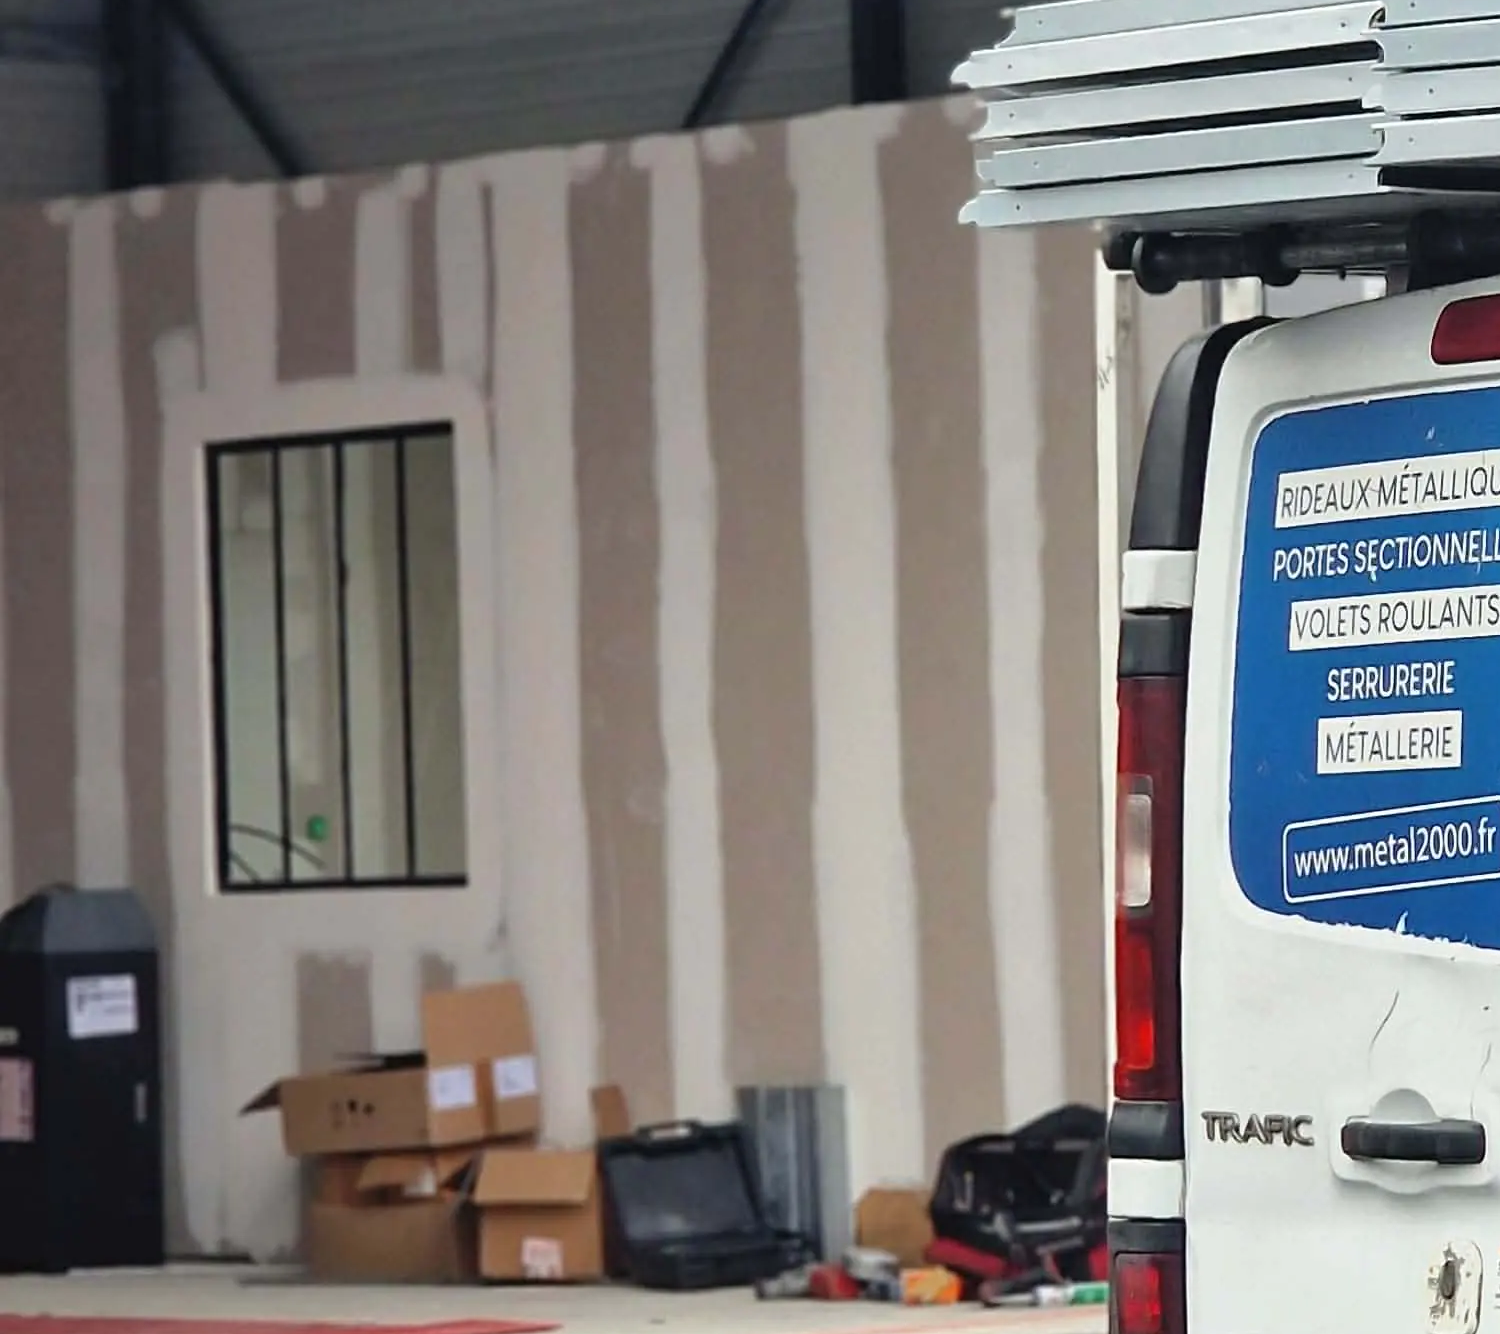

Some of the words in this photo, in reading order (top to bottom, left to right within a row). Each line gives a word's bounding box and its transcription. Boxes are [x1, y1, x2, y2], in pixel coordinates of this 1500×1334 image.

[1281, 477, 1372, 519] RIDEAUX
[1273, 542, 1349, 582] PORTES
[1294, 600, 1371, 640] VOLETS
[1376, 592, 1500, 634] ROULANTS
[1327, 660, 1456, 702] SERRURERIE
[1324, 720, 1454, 765] MÉTALLERIE
[1293, 817, 1498, 877] www.metal2000.fr
[1200, 1111, 1315, 1147] TRAFIC
